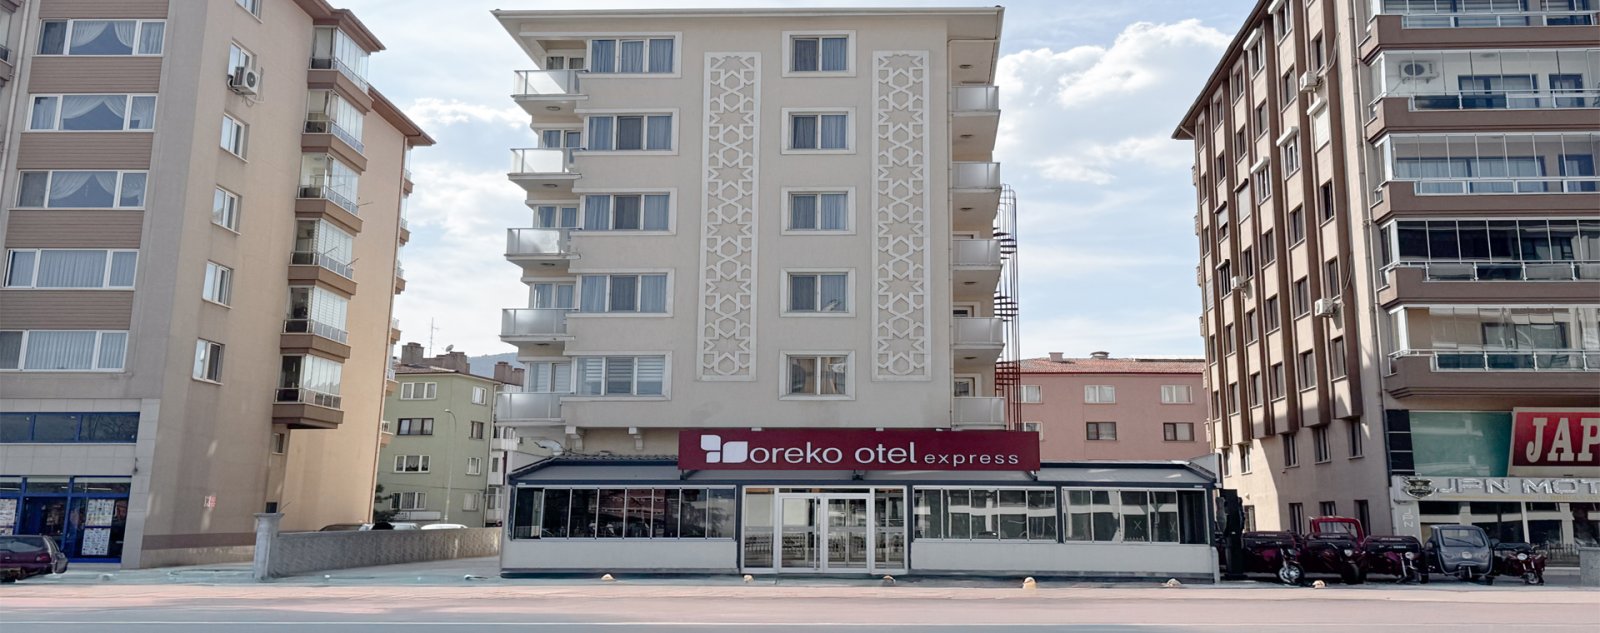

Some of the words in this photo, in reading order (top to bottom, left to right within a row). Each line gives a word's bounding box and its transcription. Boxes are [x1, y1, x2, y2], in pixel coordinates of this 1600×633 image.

[1526, 417, 1600, 463] JAP
[854, 442, 917, 464] otel
[924, 453, 1019, 467] express
[1434, 477, 1510, 495] JPN
